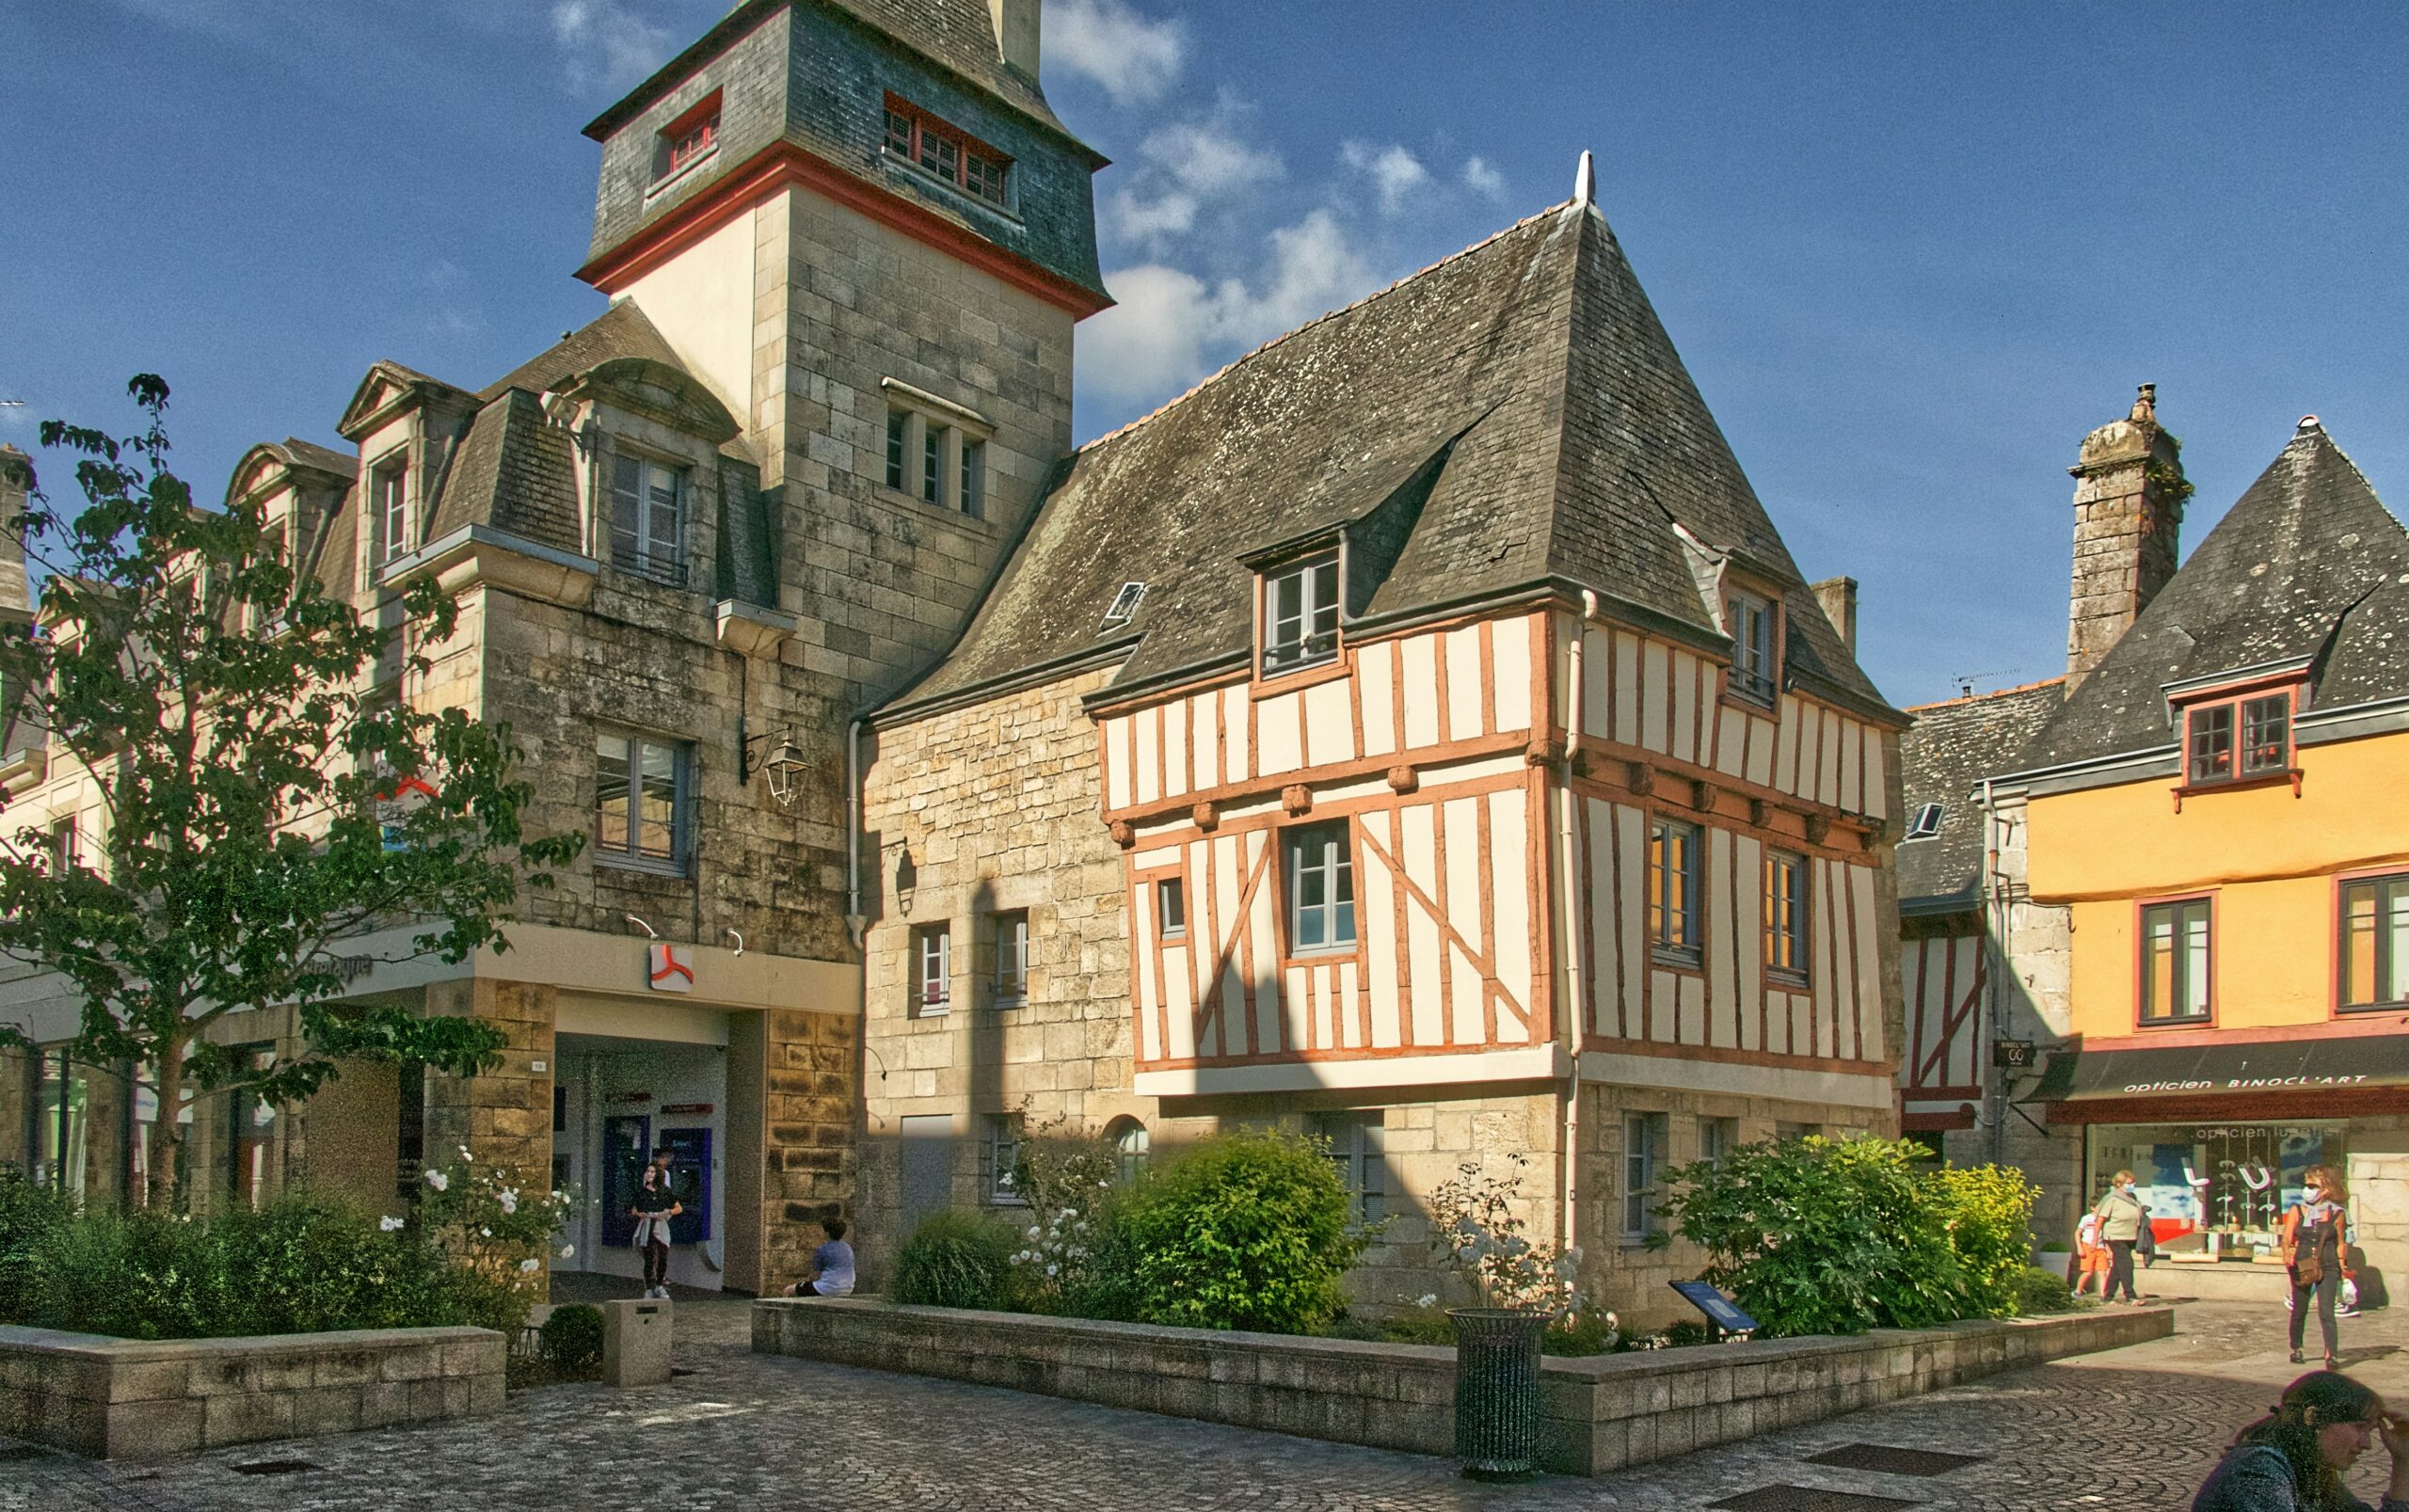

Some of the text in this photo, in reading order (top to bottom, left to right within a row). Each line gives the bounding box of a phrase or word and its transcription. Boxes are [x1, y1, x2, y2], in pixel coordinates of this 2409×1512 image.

[2123, 1074, 2368, 1093] opticien BINOCL'ART
[2196, 1126, 2266, 1140] opticien
